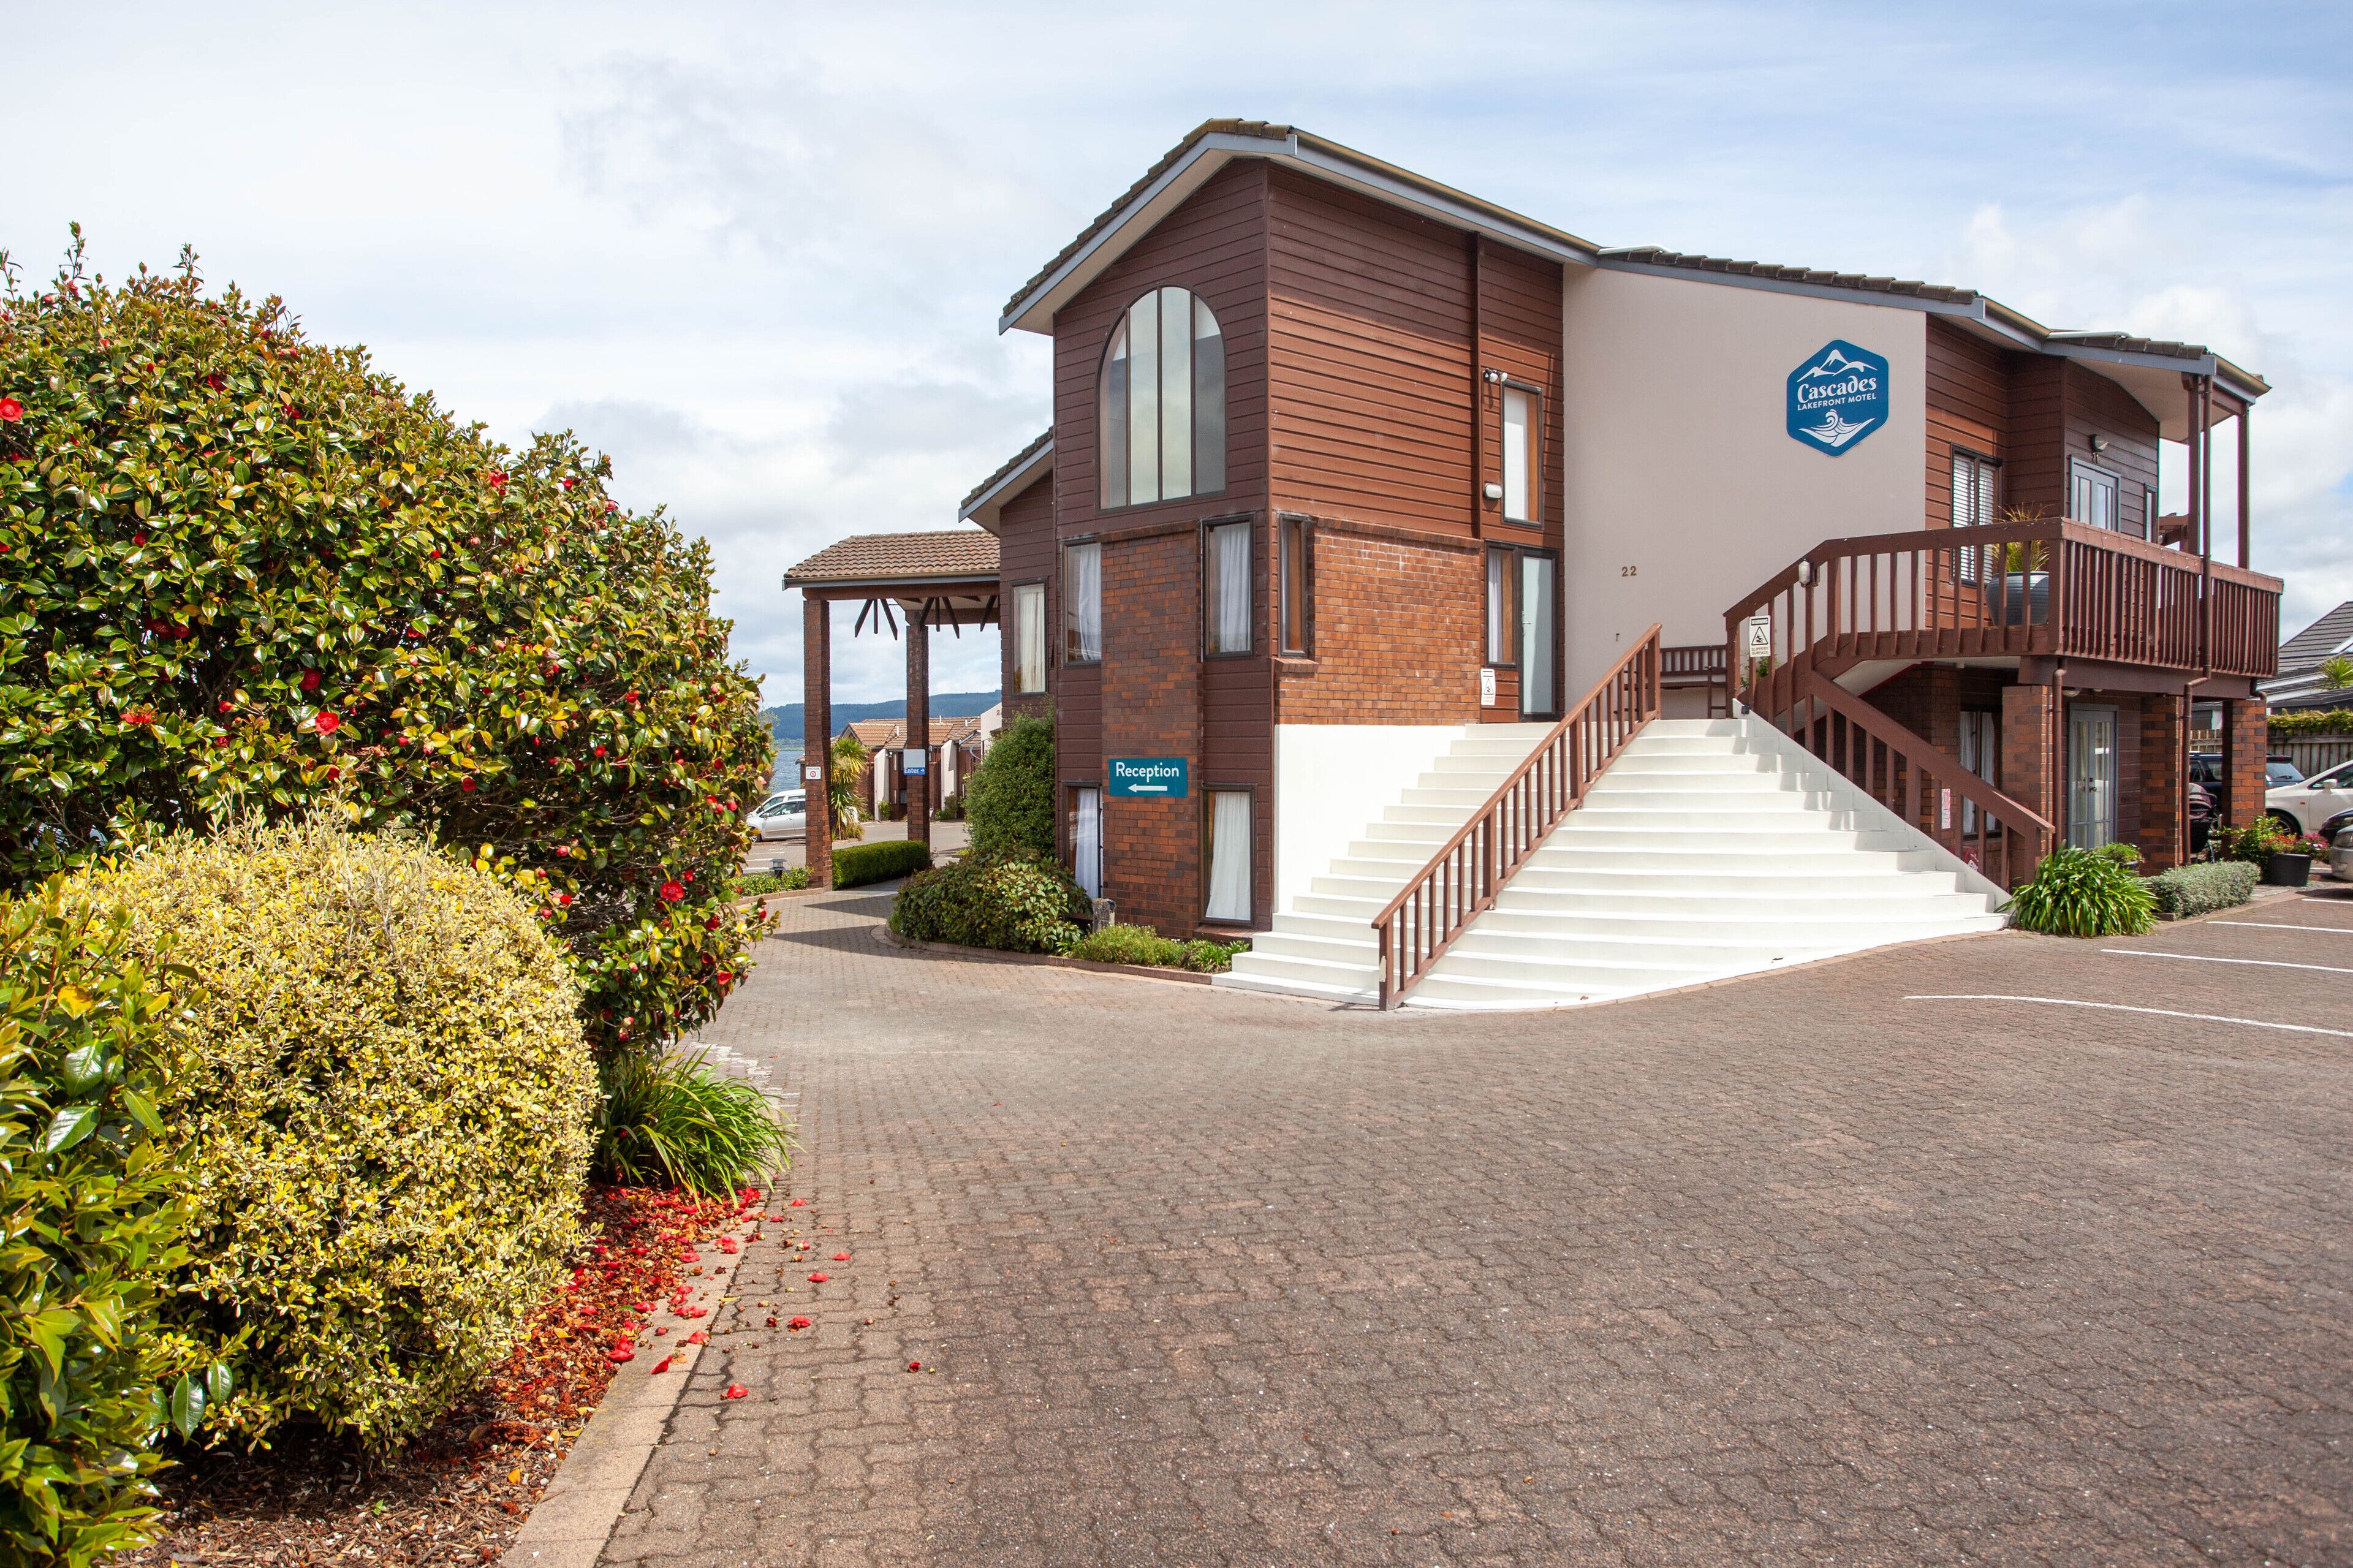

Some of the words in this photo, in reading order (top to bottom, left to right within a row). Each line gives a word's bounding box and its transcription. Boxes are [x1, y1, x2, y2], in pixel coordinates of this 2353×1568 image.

[1797, 375, 1877, 404] Cascades
[1797, 397, 1846, 411] LAKEFRONT
[1848, 393, 1876, 403] MOTEL
[1622, 566, 1637, 577] 22
[1115, 762, 1180, 782] Reception
